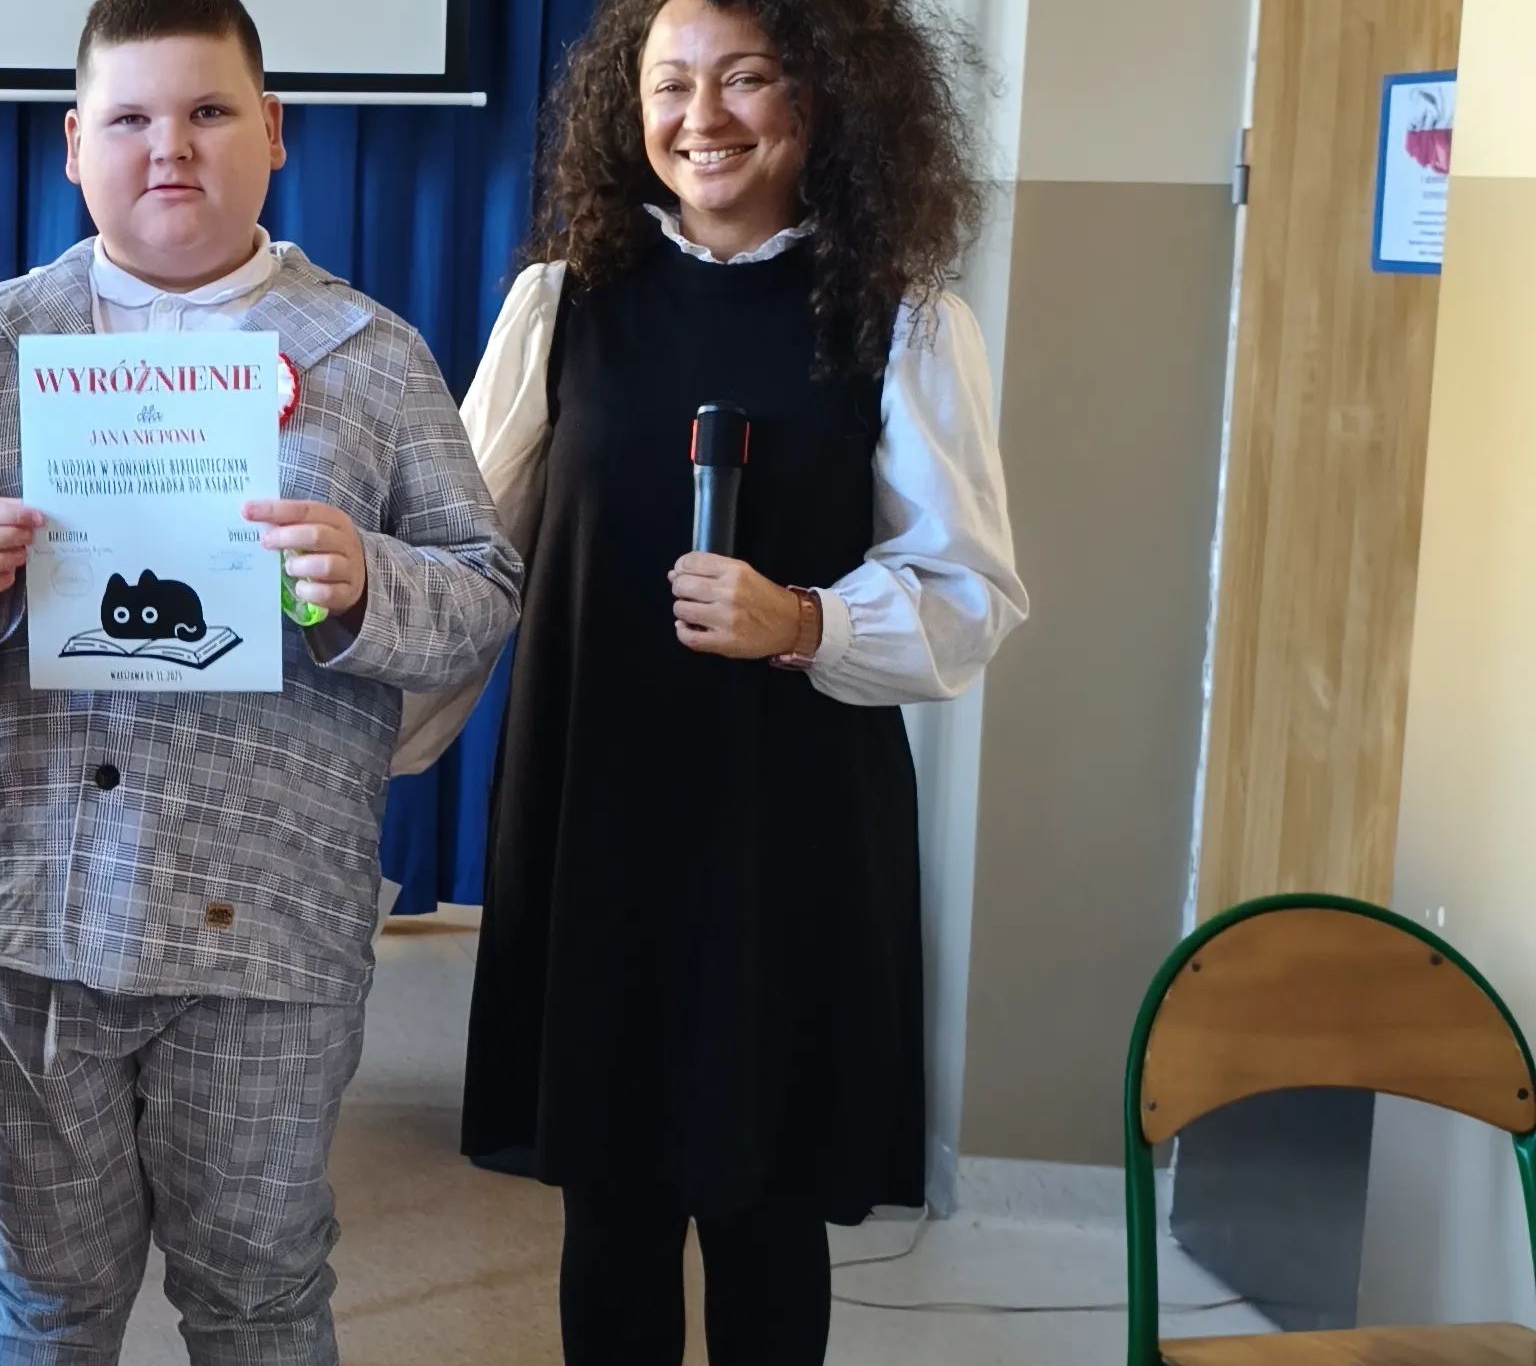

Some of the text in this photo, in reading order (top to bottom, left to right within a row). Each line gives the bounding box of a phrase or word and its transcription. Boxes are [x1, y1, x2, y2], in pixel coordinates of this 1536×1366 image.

[34, 359, 262, 394] WYRÓŻNIENIE
[136, 404, 163, 424] dla
[90, 429, 129, 446] JANA
[100, 459, 108, 476] W
[113, 459, 164, 476] KONKURSIE
[188, 476, 202, 493] DO
